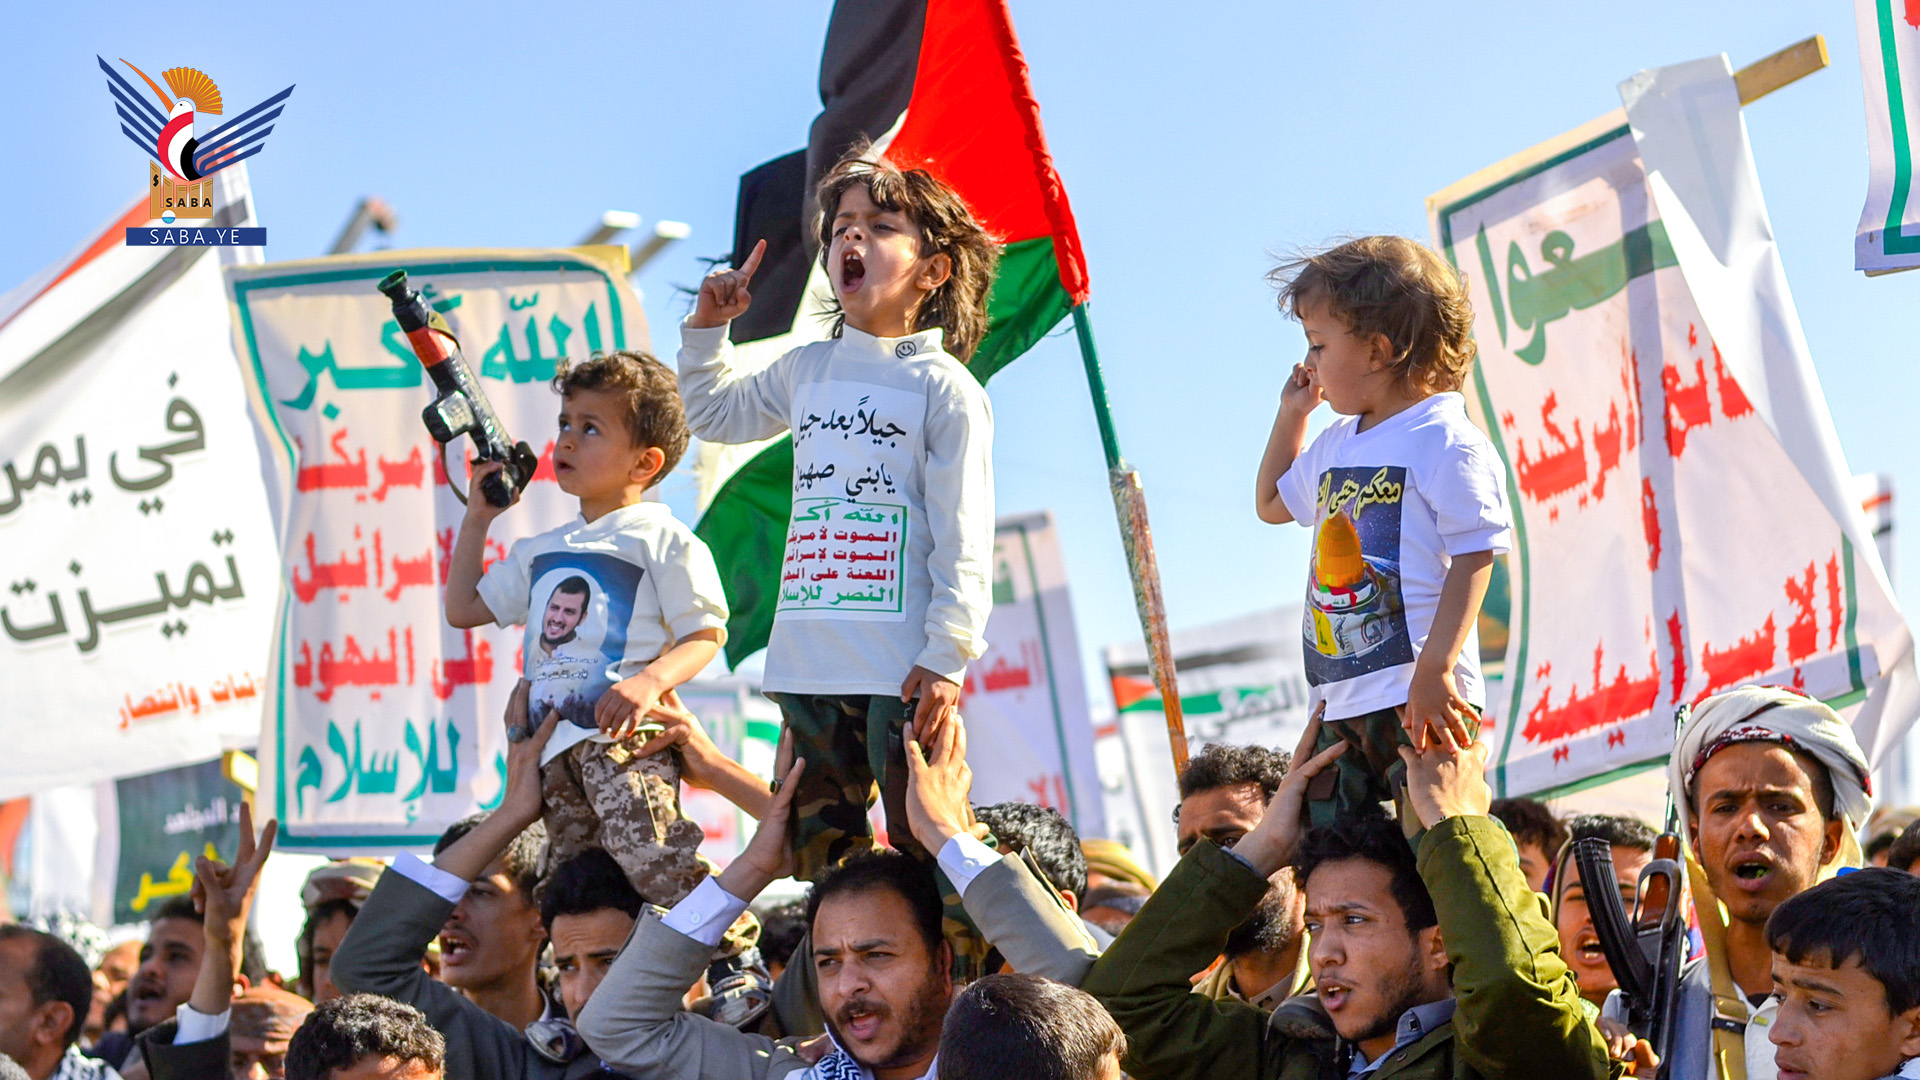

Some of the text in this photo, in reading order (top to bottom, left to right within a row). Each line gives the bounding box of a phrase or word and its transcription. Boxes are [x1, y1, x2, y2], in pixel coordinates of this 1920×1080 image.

[109, 371, 206, 516] في
[821, 408, 854, 440] بعد
[1353, 466, 1402, 521] معكم
[833, 549, 896, 563] الموت
[834, 530, 898, 544] الموت
[0, 527, 245, 656] تميزت
[810, 567, 839, 582] على
[828, 584, 897, 606] النصر
[847, 567, 896, 582] اللعنة
[293, 625, 415, 703] اليهود
[431, 627, 494, 701] على
[295, 716, 461, 828] للإسلام
